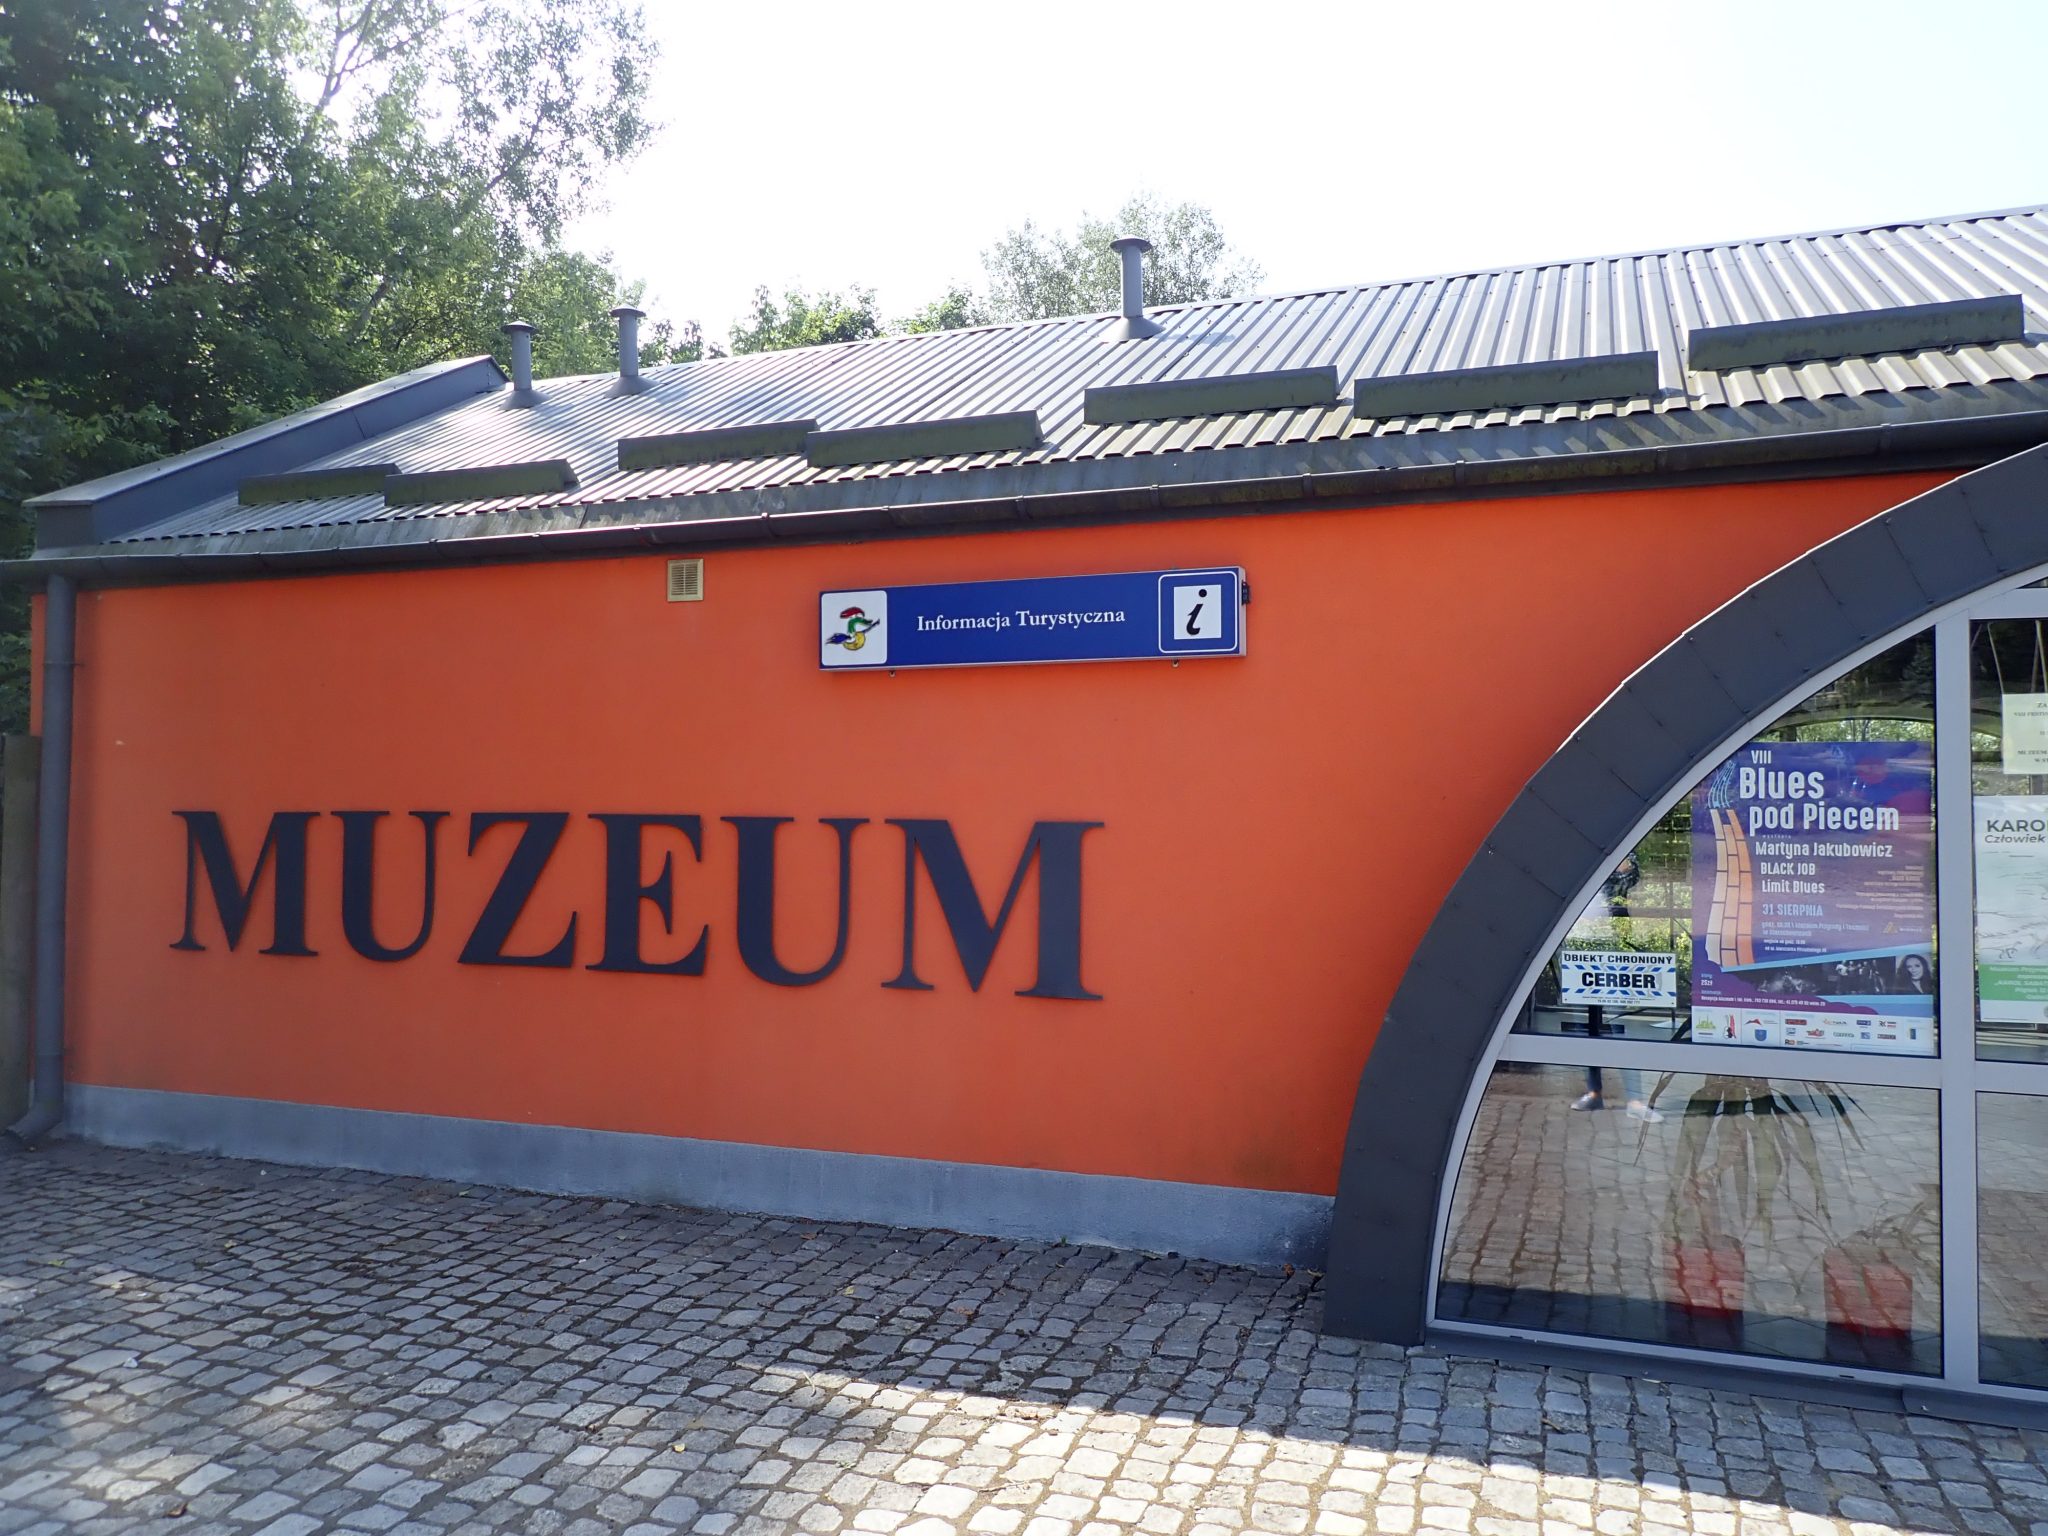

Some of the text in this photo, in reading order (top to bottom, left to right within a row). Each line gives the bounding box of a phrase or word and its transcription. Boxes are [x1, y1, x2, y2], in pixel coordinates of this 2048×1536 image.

[916, 610, 1126, 632] Informacja Turystyczna
[1751, 750, 1772, 764] VIII
[1739, 767, 1825, 800] Blues
[1749, 801, 1899, 837] pod Piecem
[1986, 819, 2048, 833] KARO
[1984, 833, 2047, 844] Człowiek
[1755, 841, 1893, 860] Martyna Jakubowicz
[1760, 862, 1816, 876] BLACK JOB
[1762, 879, 1825, 894] Limit Blues
[169, 810, 1105, 1001] MUZEUM
[1762, 903, 1774, 916] 31
[1776, 903, 1823, 917] SIERPNIA
[1563, 953, 1673, 965] OBIEKT CHRONIONY
[1581, 972, 1656, 989] CERBER
